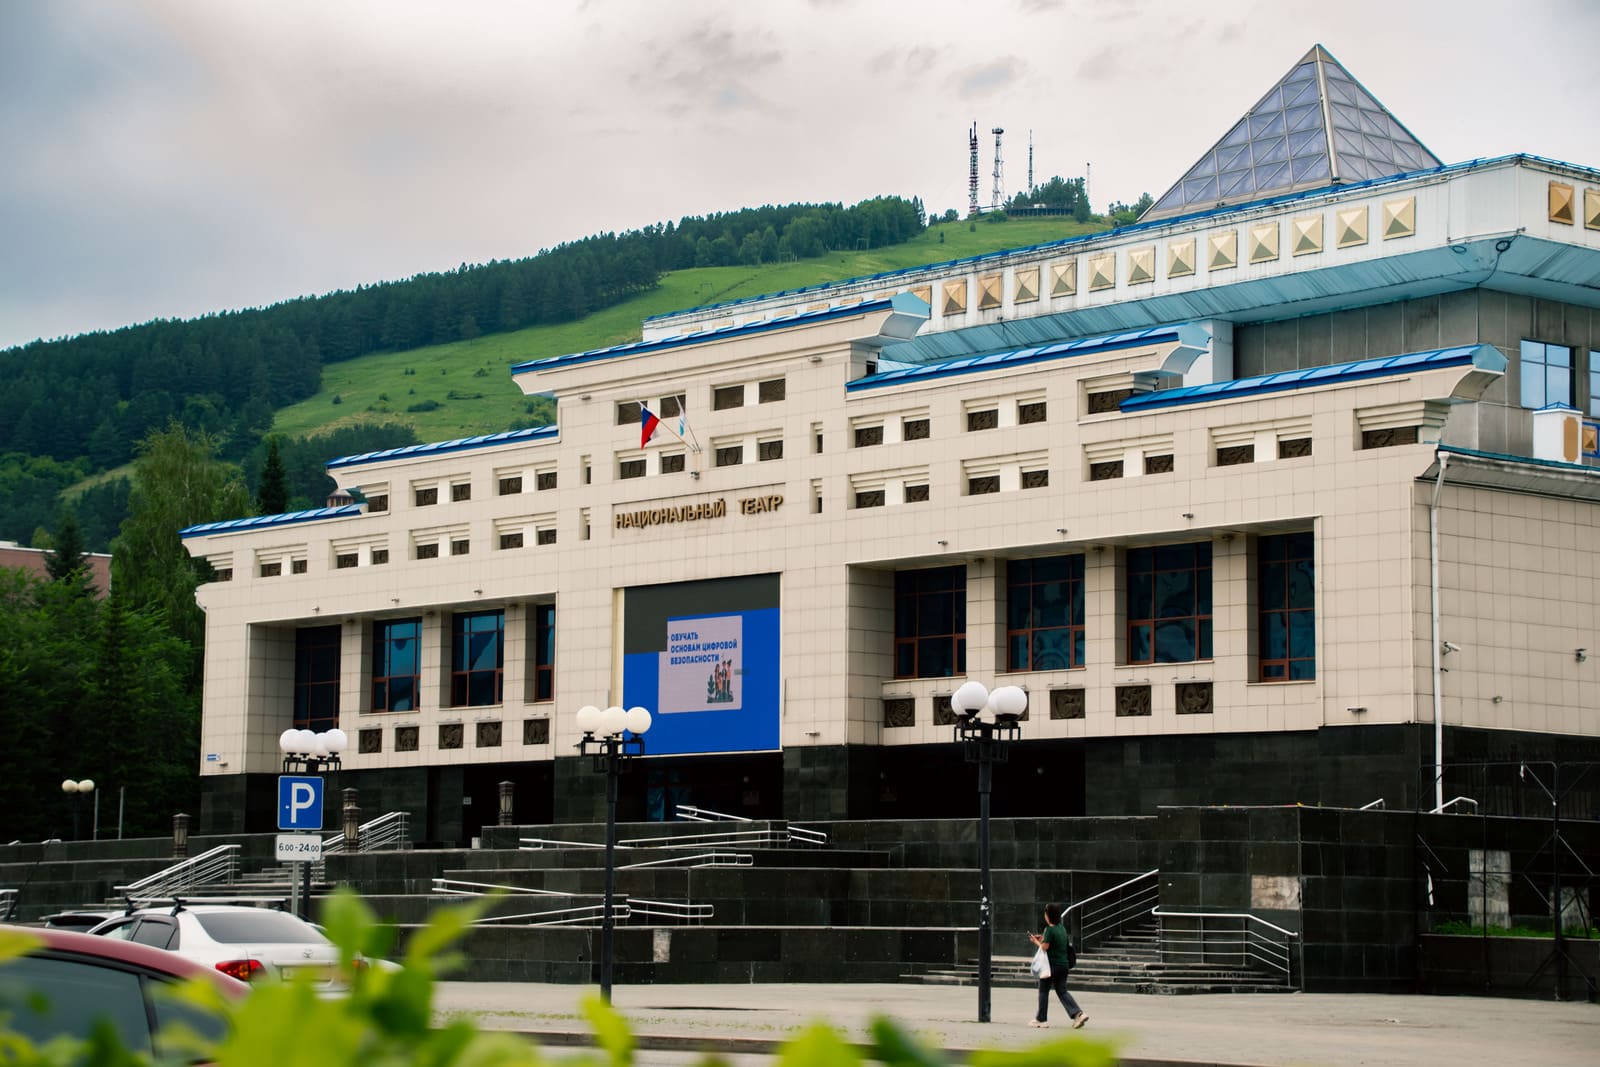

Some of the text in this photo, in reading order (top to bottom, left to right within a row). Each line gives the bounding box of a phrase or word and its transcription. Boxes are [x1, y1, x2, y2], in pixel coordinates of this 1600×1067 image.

[615, 494, 784, 529] НАЦИОНАЛЬНЫЙ ТЕАТР
[671, 632, 698, 642] ОБУЧАТЬ
[671, 638, 738, 654] ОСНОВАМ ЦИФРОВОЙ
[670, 654, 720, 665] БЕЗОПАСНОСТИ
[291, 782, 315, 823] P
